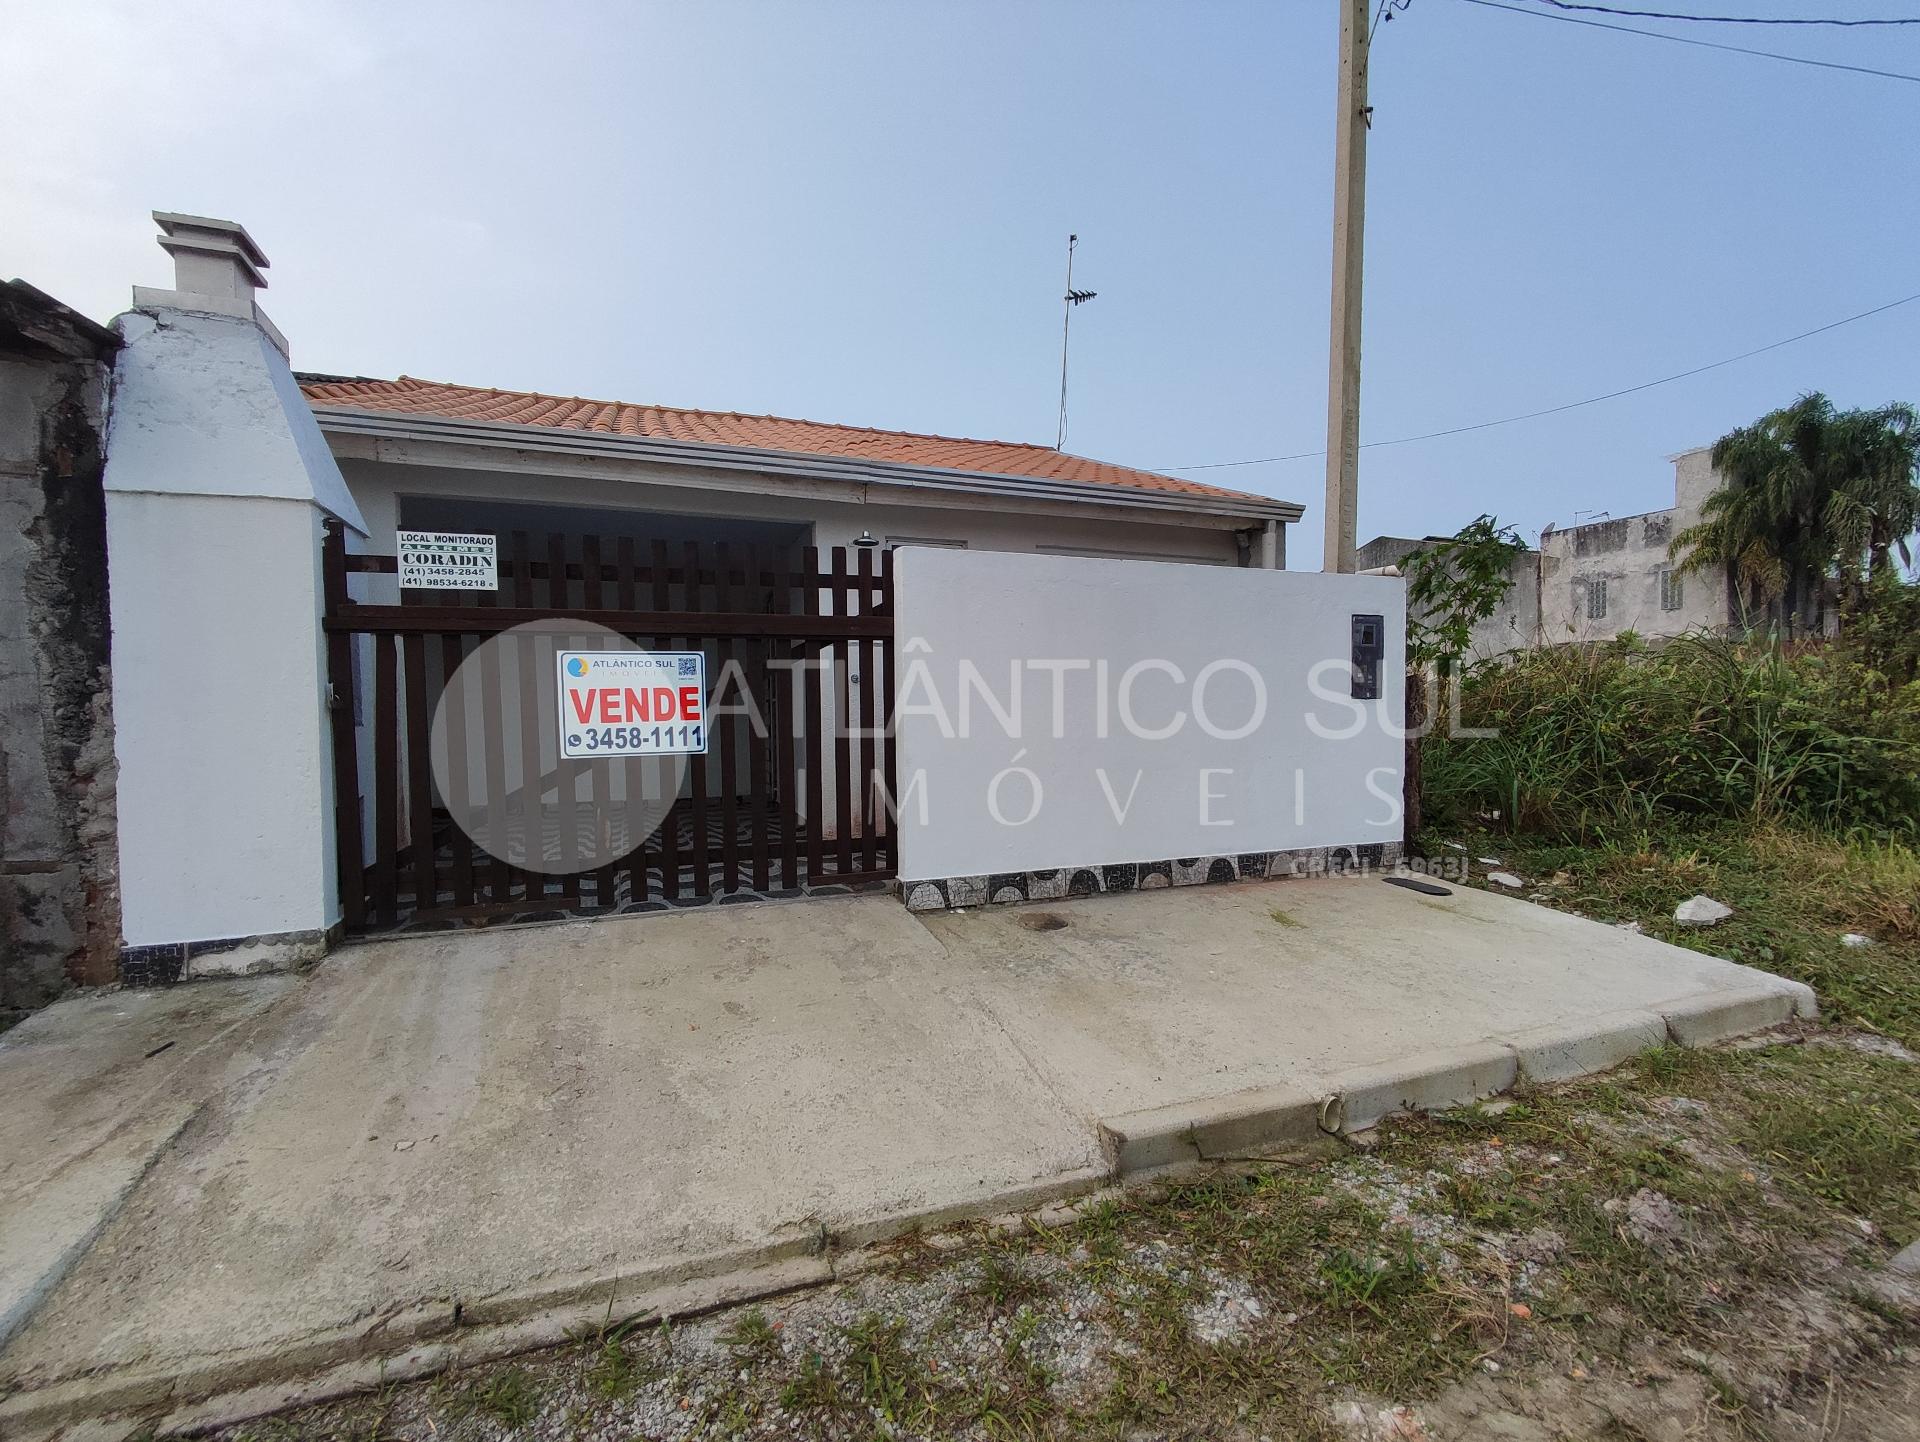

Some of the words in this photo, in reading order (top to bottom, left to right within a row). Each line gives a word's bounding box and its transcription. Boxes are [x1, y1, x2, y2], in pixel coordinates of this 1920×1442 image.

[401, 534, 430, 542] LOCAL
[434, 535, 494, 545] MONITORADO
[402, 544, 493, 553] ALARMES
[403, 553, 492, 567] CORADIN
[402, 578, 422, 586] (41)
[426, 579, 486, 587] 98534-6218
[592, 658, 652, 668] ATLÂNTICO
[655, 660, 675, 668] SUL
[569, 687, 701, 724] VENDE
[585, 725, 701, 750] 3458-1111
